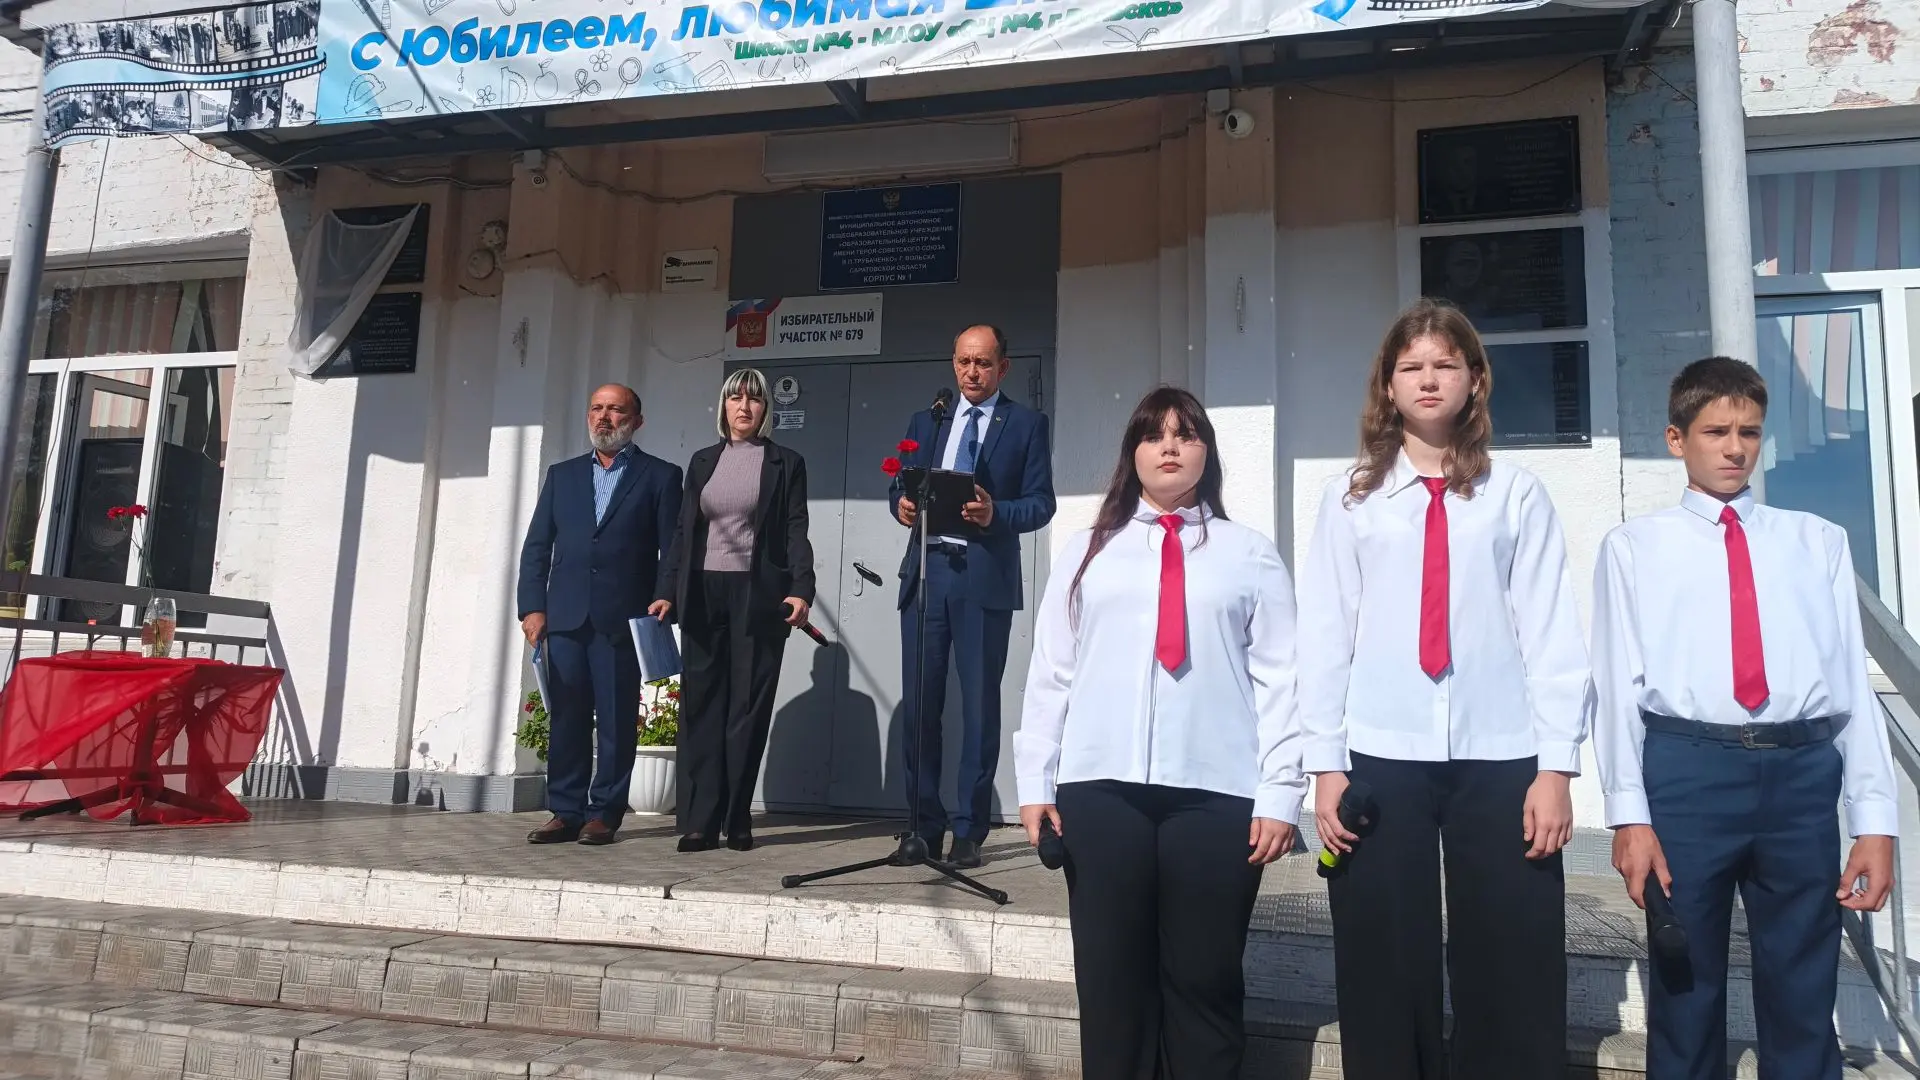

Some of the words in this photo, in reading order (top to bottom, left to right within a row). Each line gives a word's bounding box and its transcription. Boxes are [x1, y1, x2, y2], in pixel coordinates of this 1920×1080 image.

[734, 38, 809, 60] Школа
[813, 30, 853, 52] №4
[871, 21, 943, 47] МАОУ
[1000, 11, 1044, 34] №4
[839, 220, 895, 229] МУНИЦИПАЛЬНОЕ
[897, 217, 941, 226] АВТОНОМНОЕ
[910, 225, 953, 234] УЧРЕЖДЕНИЕ
[834, 249, 855, 257] ИМЕНИ
[878, 245, 919, 254] СОВЕТСКОГО
[849, 264, 895, 273] САРАТОВСКОЙ
[896, 263, 926, 271] ОБЛАСТИ
[863, 274, 895, 283] КОРПУС
[897, 273, 906, 281] №
[780, 308, 874, 327] ИЗБИРАТЕЛЬНЫЙ
[779, 330, 827, 344] УЧАСТОК
[830, 331, 842, 342] №
[845, 329, 863, 341] 679
